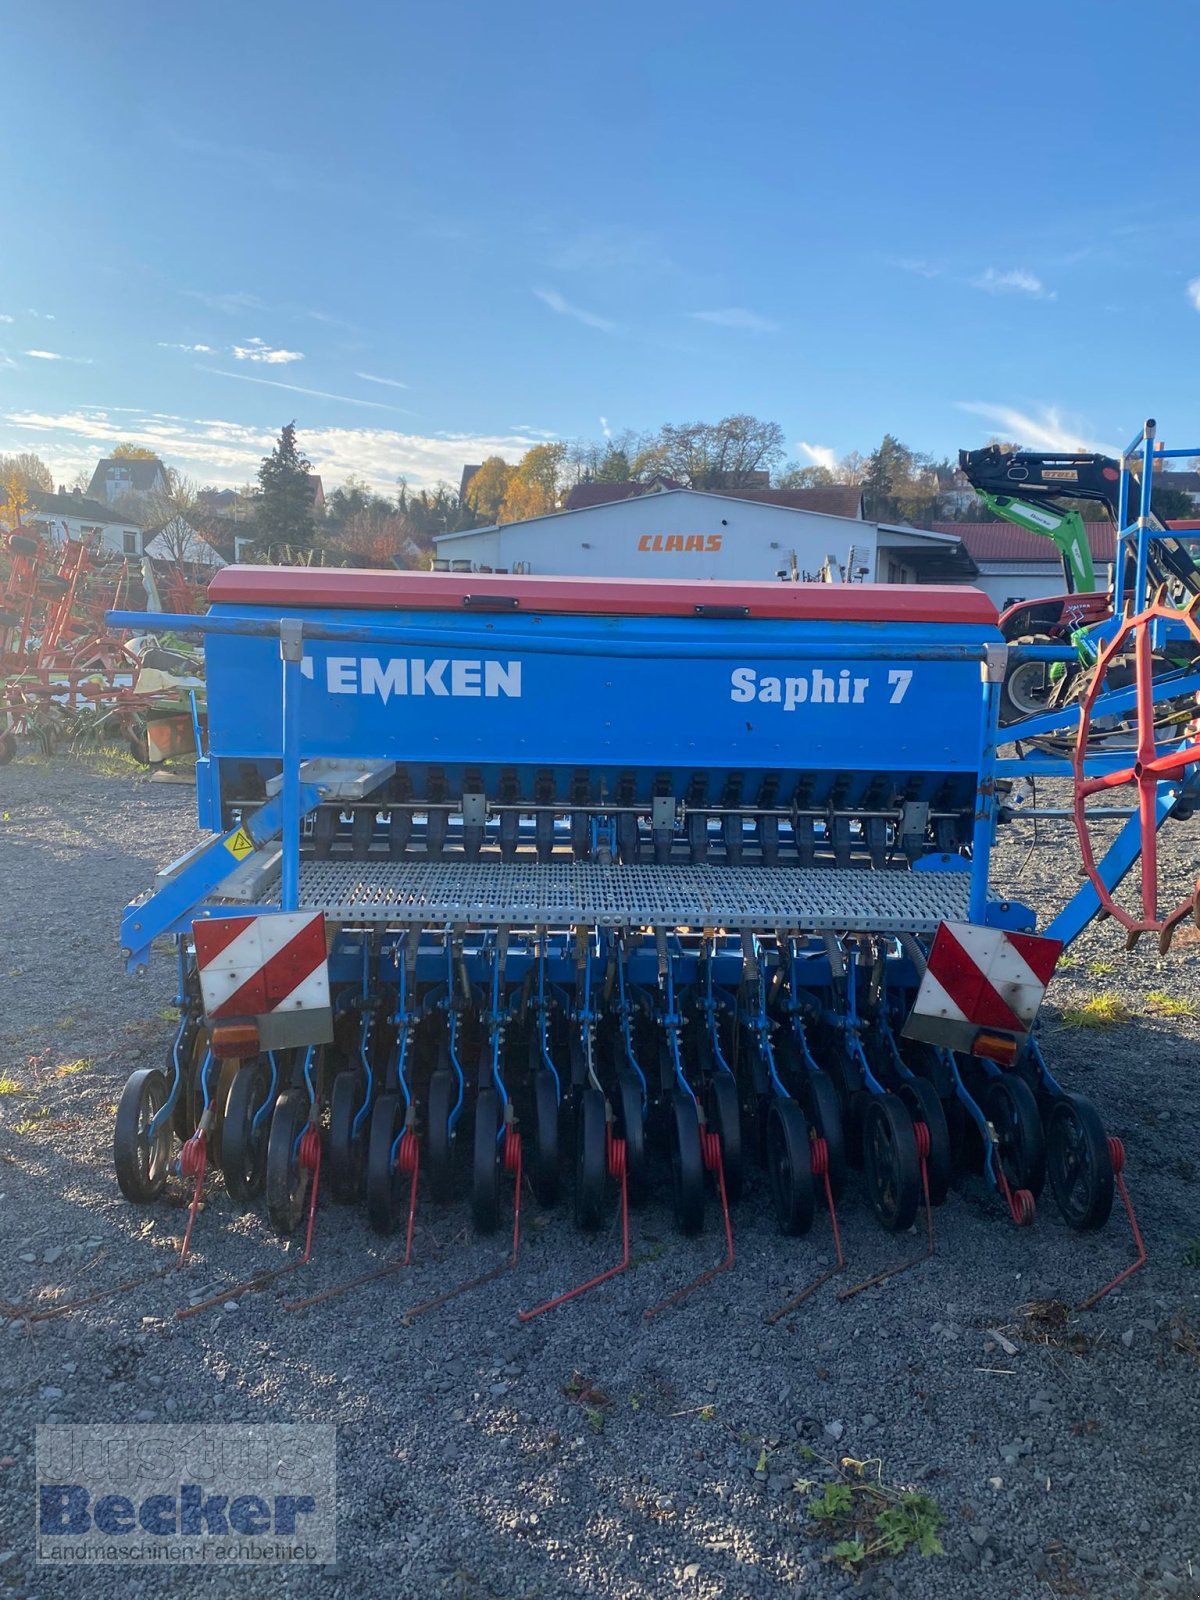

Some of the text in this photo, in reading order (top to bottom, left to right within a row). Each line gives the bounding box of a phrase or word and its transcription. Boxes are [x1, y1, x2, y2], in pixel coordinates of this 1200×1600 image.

[638, 534, 722, 552] CLAAS
[731, 667, 913, 711] Saphir 7
